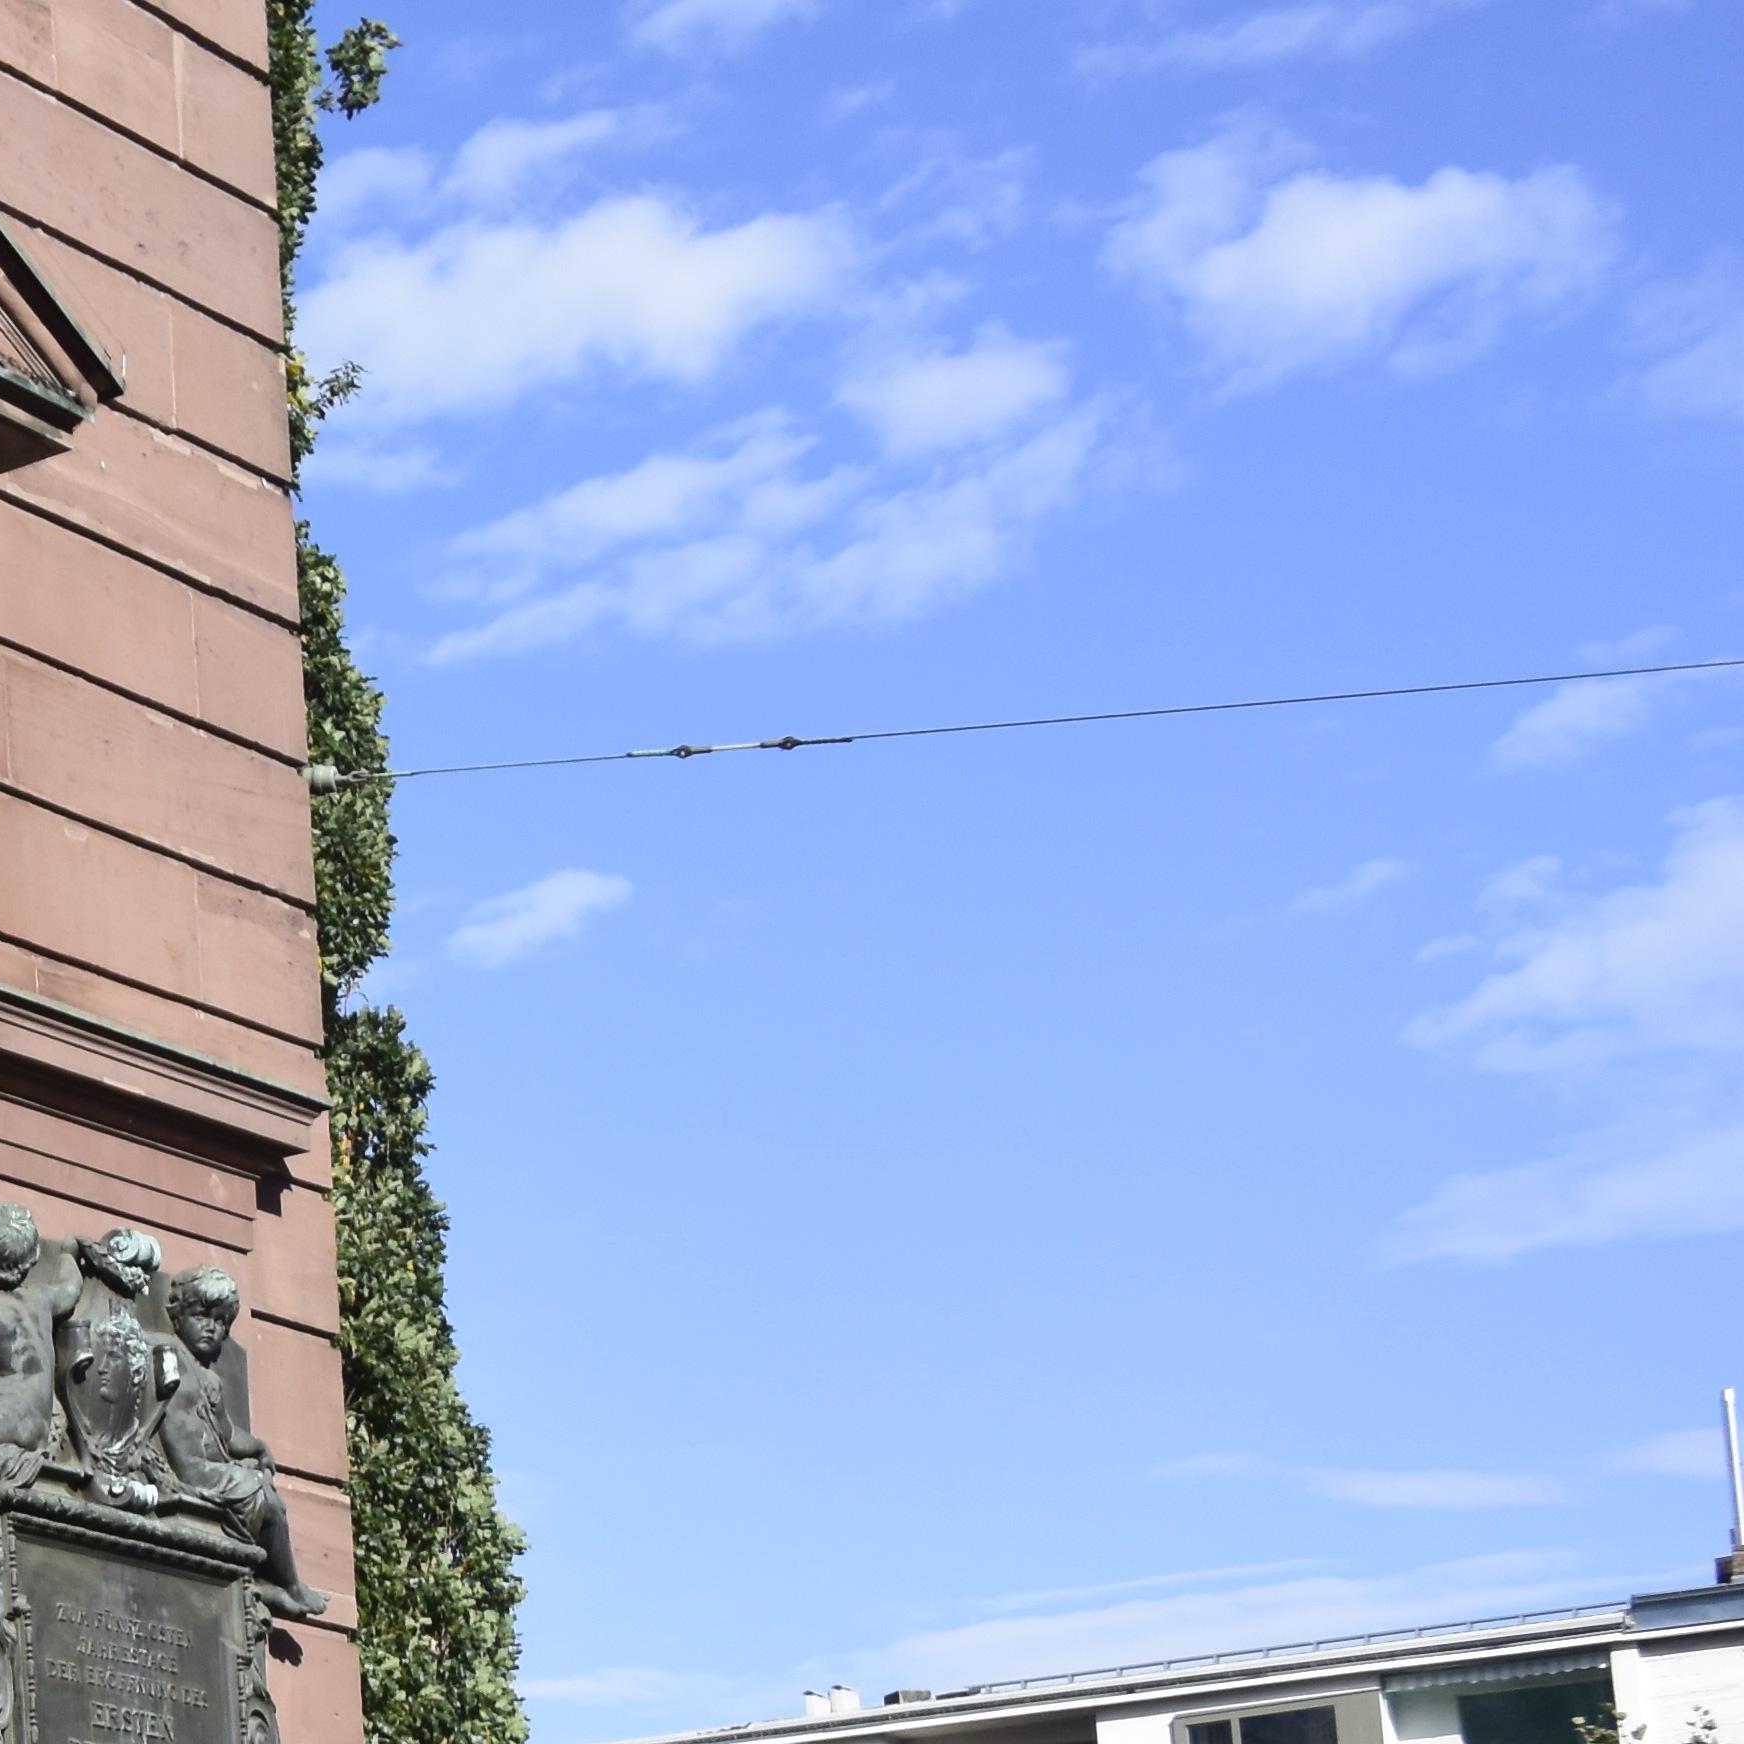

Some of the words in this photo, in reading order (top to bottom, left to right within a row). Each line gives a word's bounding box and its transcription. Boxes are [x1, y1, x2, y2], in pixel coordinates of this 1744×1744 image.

[55, 1601, 90, 1627] ZUM
[93, 1606, 194, 1649] FÜNFZIGSTEN
[75, 1635, 179, 1676] JAHRESTAGE
[45, 1657, 81, 1684] DER
[85, 1664, 178, 1702] ERÖFFNUNG
[181, 1684, 209, 1710] DES
[88, 1700, 175, 1742] ERSTEN
